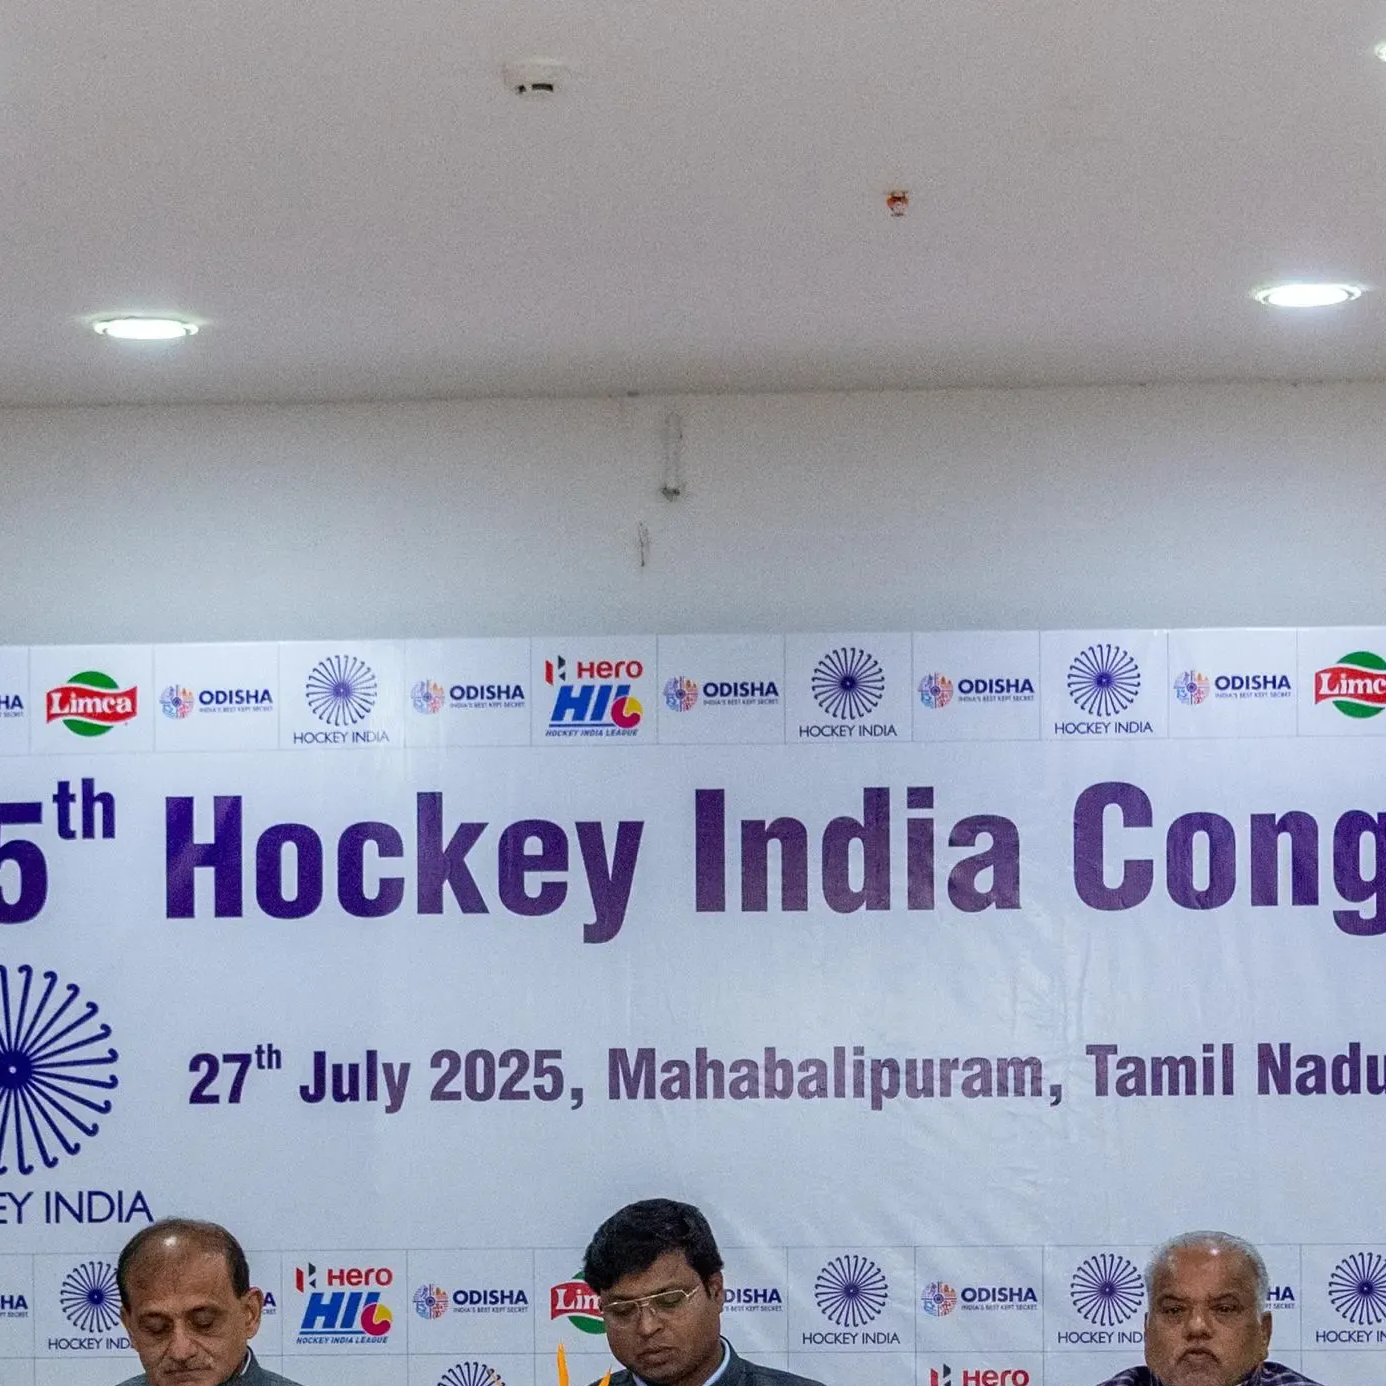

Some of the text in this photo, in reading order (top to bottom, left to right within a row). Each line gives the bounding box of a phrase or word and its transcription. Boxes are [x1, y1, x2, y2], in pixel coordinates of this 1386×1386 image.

[578, 661, 643, 679] Hero
[703, 682, 779, 697] ODISHA
[958, 679, 1035, 694] ODISHA
[1215, 675, 1292, 691] ODISHA
[199, 689, 273, 705] ODISHA
[450, 685, 525, 700] ODISHA
[50, 692, 133, 714] Limca
[606, 728, 638, 736] LEAGUE
[799, 725, 897, 737] HOCKEY INDIA
[1055, 721, 1153, 734] HOCKEY INDIA
[294, 731, 390, 744] HOCKEY INDIA
[166, 792, 644, 943] Hockey
[695, 787, 1020, 913] India
[300, 1050, 410, 1113] July
[431, 1049, 583, 1110] 2025,
[609, 1047, 1061, 1110] Mahabalipuram,
[1086, 1044, 1233, 1097] Tamil
[46, 1191, 153, 1224] INDIA
[328, 1268, 392, 1286] Hero
[453, 1290, 529, 1305] ODISHA
[724, 1288, 782, 1304] DISHA
[961, 1288, 1038, 1303] ODISHA
[48, 1337, 130, 1349] HOCKEY IND
[803, 1332, 900, 1344] HOCKEY INDIA
[1058, 1332, 1143, 1343] HOCKEY IND
[1316, 1330, 1372, 1342] HOCKEY
